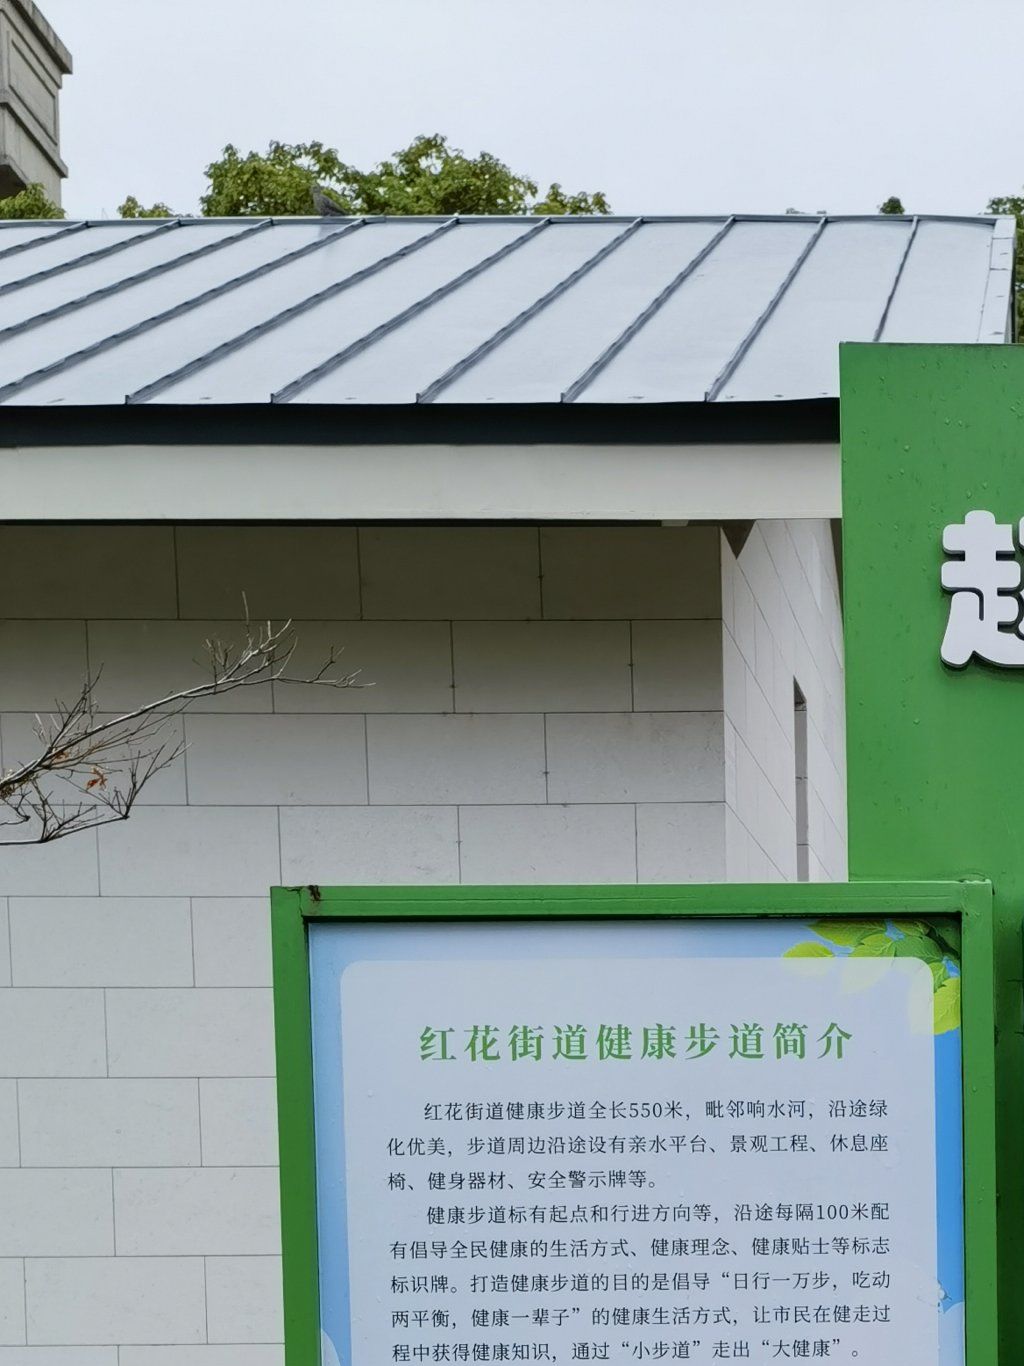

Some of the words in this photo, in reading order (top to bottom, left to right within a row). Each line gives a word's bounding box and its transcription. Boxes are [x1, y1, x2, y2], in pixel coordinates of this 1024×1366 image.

[420, 1022, 853, 1061] 红花街道健康步道简介
[387, 1134, 888, 1157] 化优美，步道周边沿途设有亲水平台、景观工程、休息座
[388, 1170, 656, 1190] 椅、健身器材、安全警示牌等。
[427, 1203, 890, 1225] 健康步道标有起点和行进方向等，沿途每隔100米配
[390, 1237, 890, 1259] 有倡导全民健康的生活方式、健康理念、健康贴士等标志
